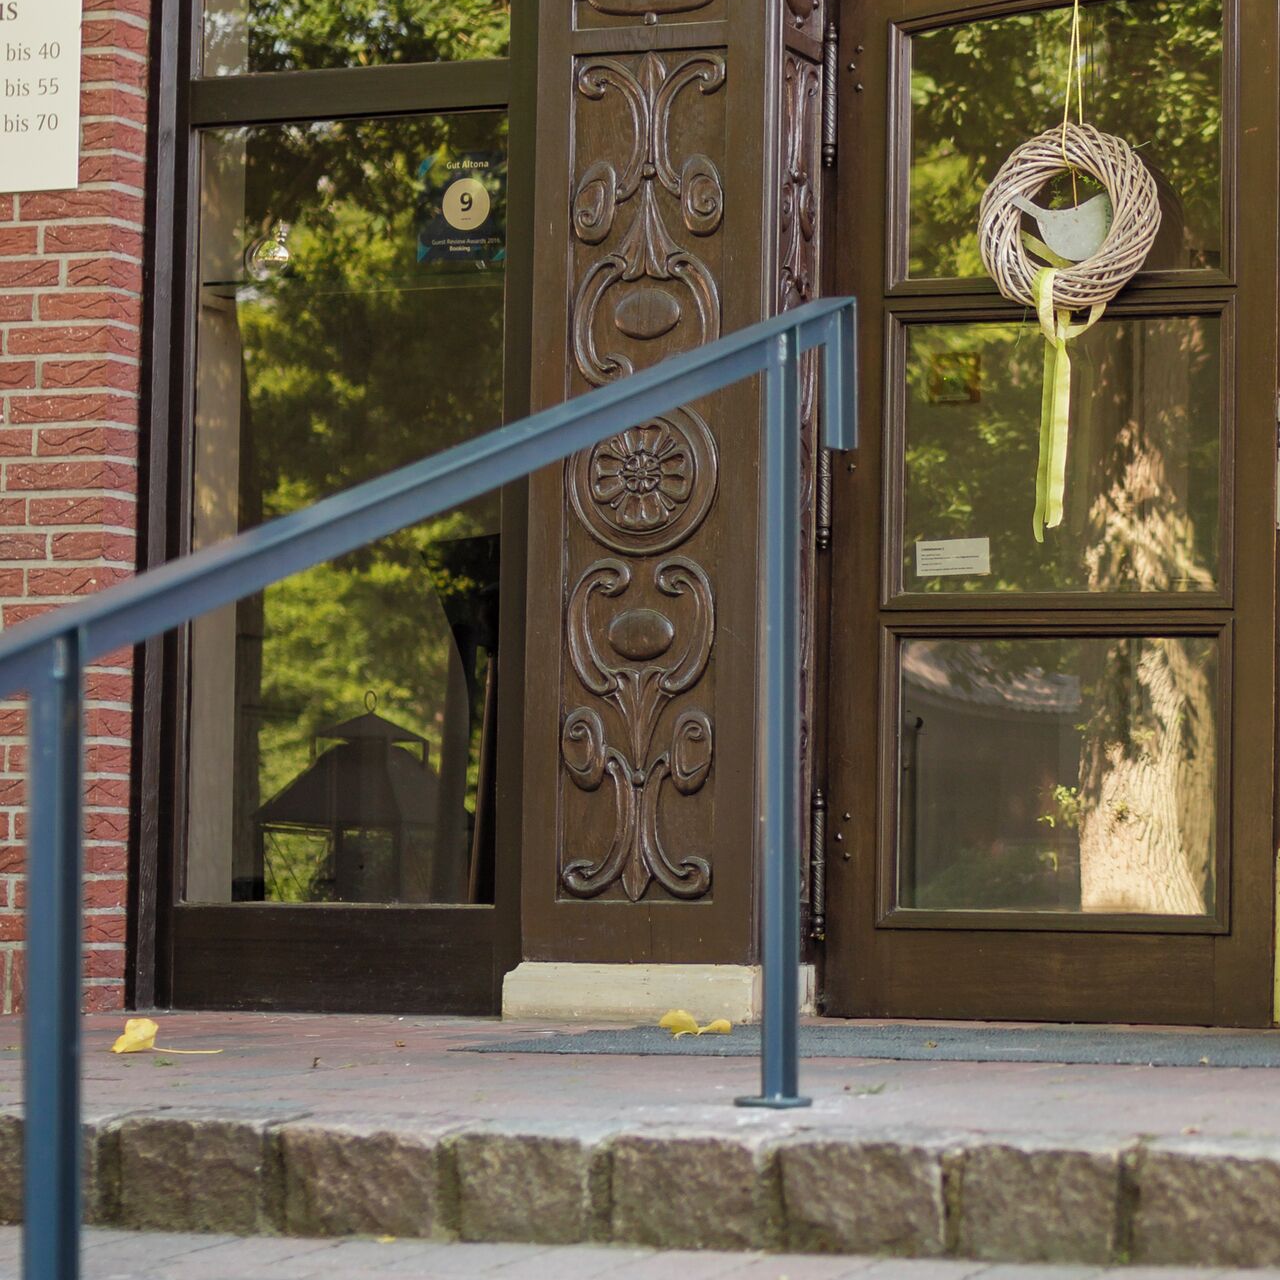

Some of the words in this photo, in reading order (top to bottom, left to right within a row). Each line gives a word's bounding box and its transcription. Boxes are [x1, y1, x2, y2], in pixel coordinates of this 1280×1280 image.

[6, 42, 31, 62] bis
[38, 40, 61, 60] 40
[5, 78, 30, 98] bis
[37, 77, 59, 96] 55
[4, 114, 29, 133] bis
[36, 112, 59, 131] 70
[446, 161, 460, 170] Gut
[461, 160, 489, 169] Altona
[460, 192, 473, 212] 9
